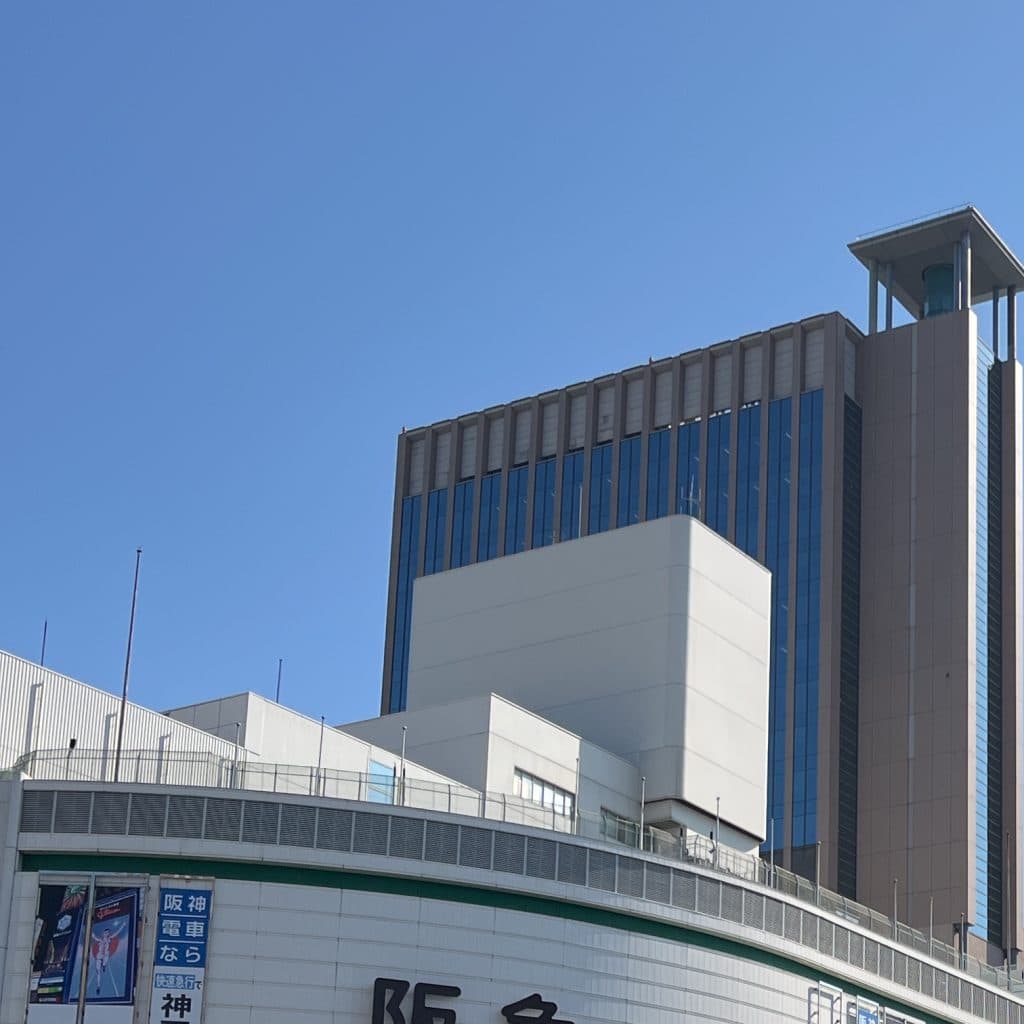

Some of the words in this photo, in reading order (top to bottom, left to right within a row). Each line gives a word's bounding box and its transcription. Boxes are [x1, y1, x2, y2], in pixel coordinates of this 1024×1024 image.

[163, 893, 206, 912] 阪神
[161, 919, 205, 938] 電車
[159, 945, 201, 964] なら
